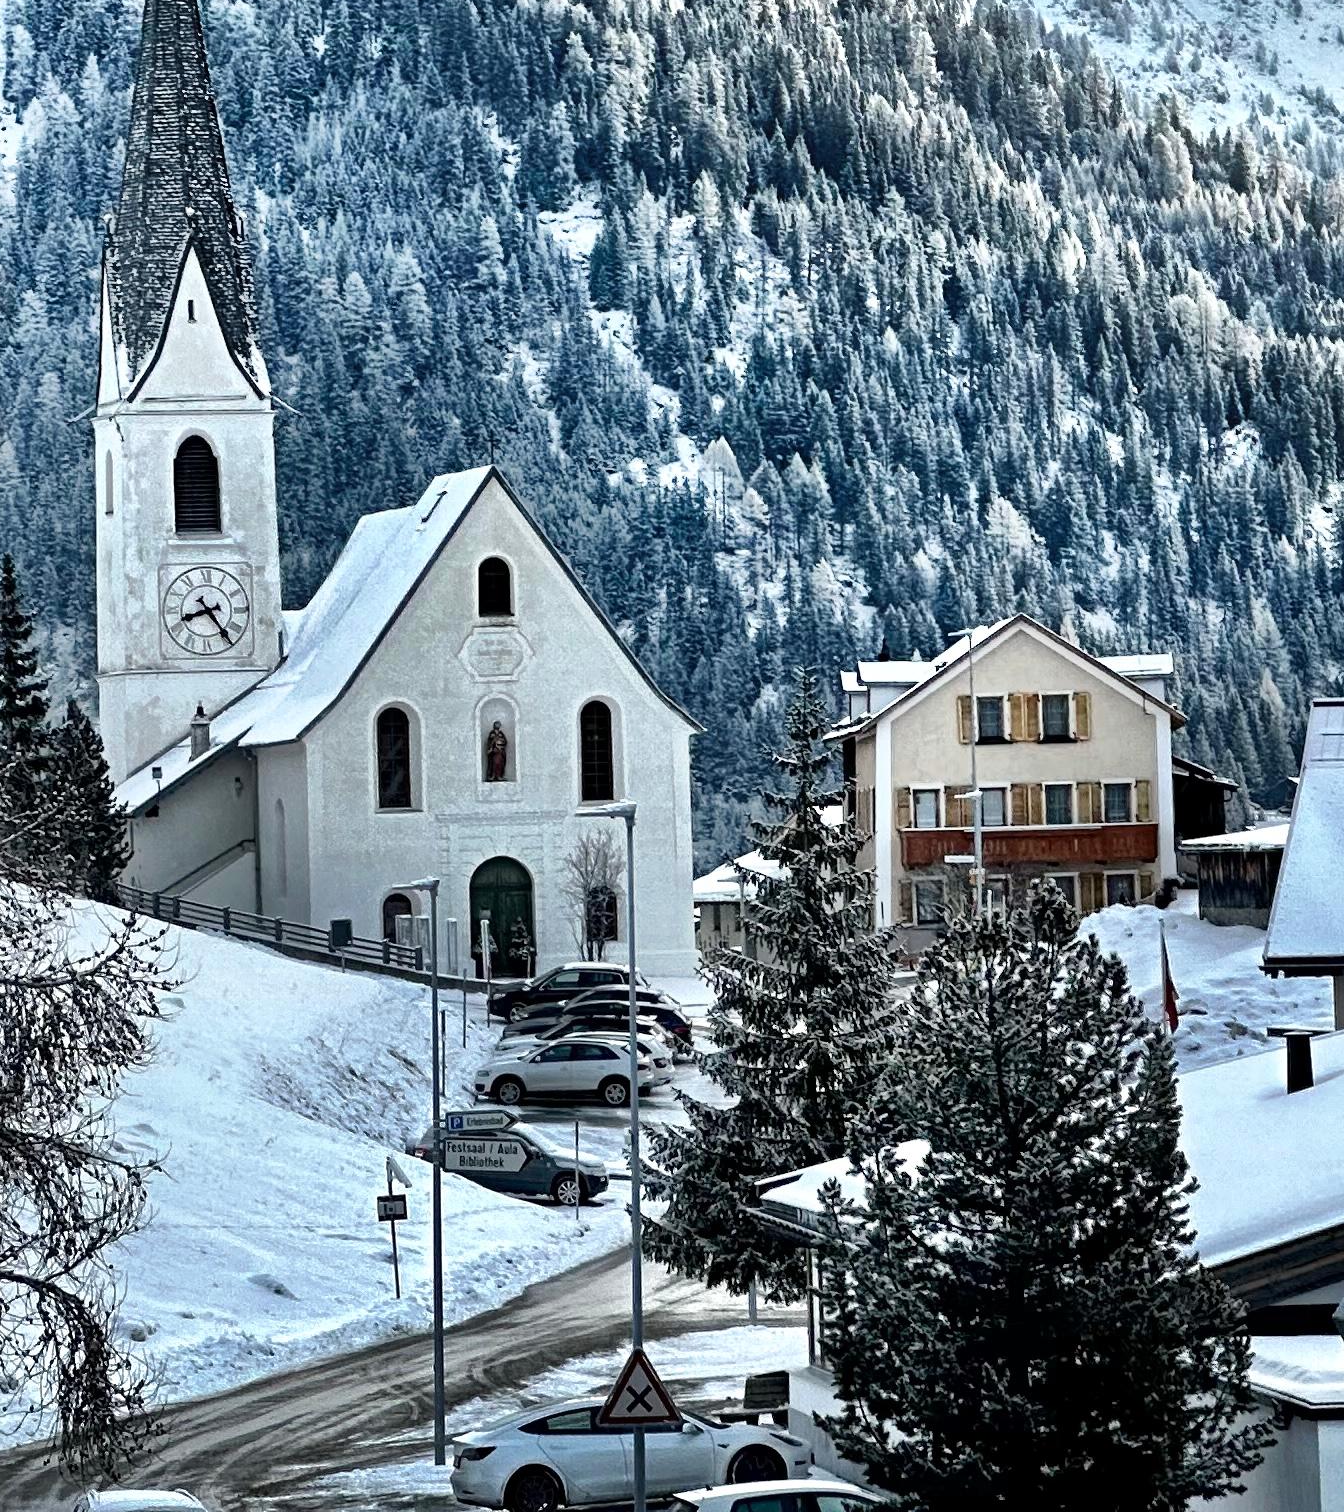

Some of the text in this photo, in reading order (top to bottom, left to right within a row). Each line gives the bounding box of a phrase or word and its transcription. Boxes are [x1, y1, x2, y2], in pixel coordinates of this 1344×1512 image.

[453, 1117, 461, 1128] P
[447, 1141, 486, 1154] Festsaal
[498, 1143, 518, 1155] Aula
[459, 1155, 505, 1168] Bibliothek
